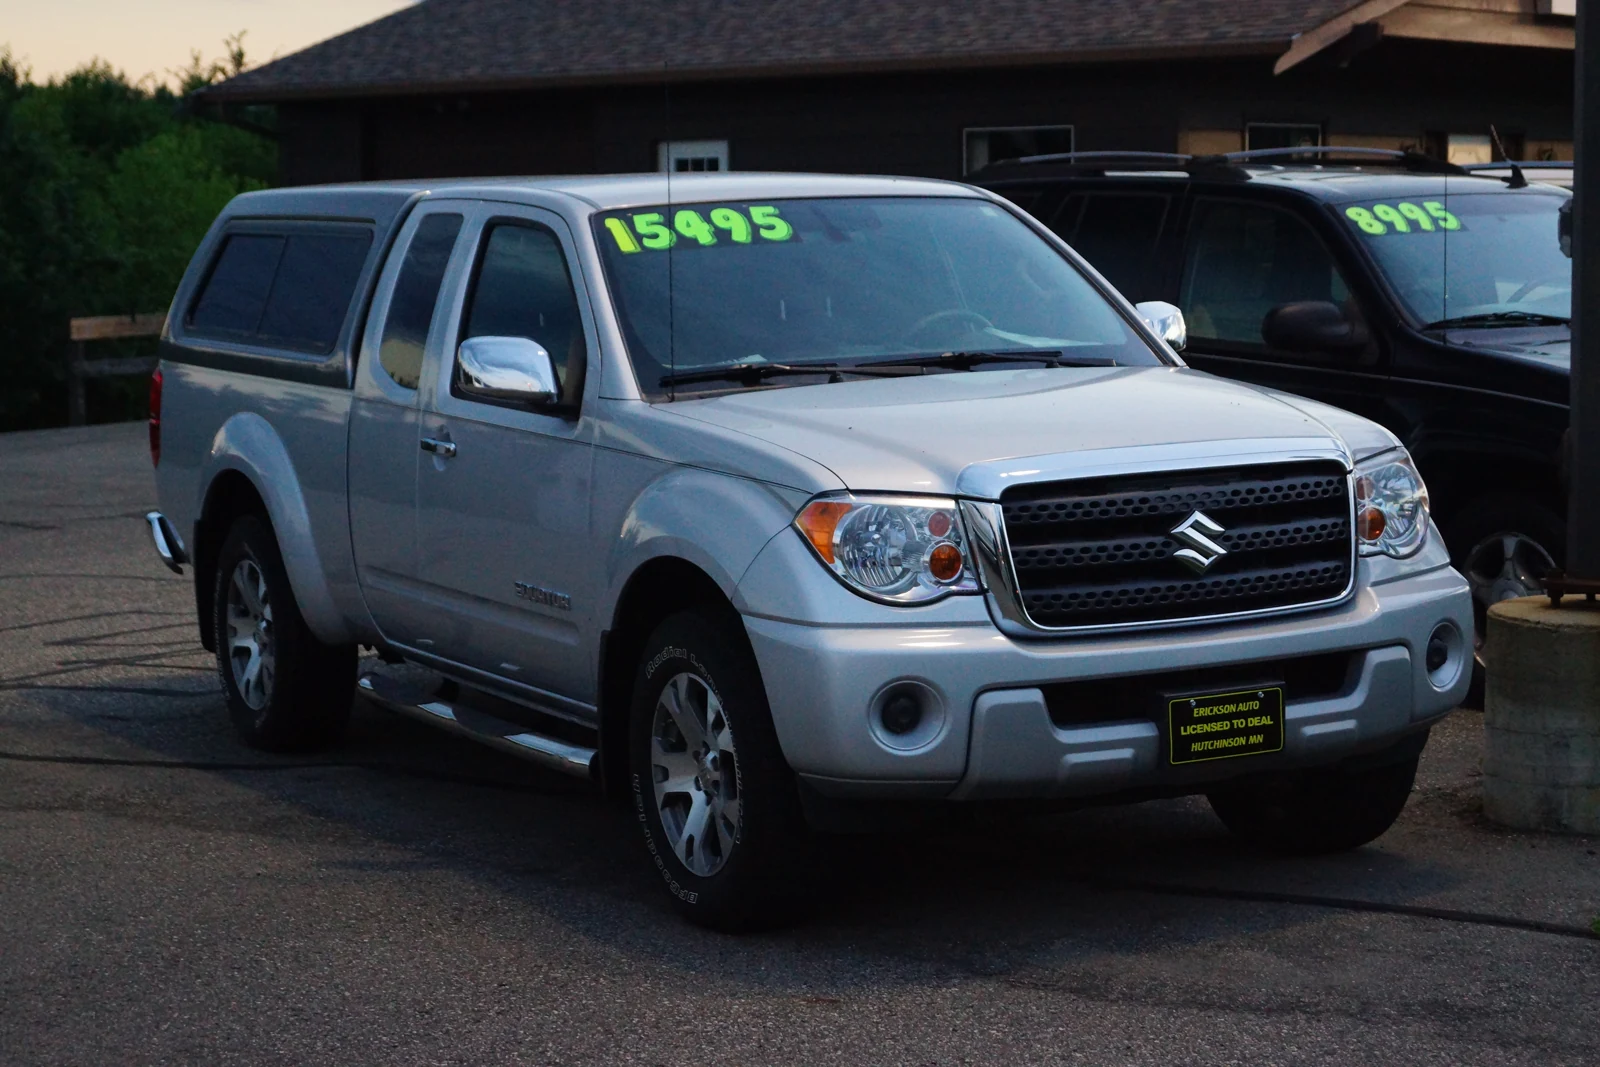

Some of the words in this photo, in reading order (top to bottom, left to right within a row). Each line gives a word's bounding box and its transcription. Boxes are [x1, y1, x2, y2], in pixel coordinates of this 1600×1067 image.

[604, 206, 793, 254] 15495
[1345, 201, 1461, 235] 8995
[645, 645, 688, 679] Radial
[1193, 703, 1237, 718] ERICKSON
[1237, 700, 1260, 712] AUTO
[1180, 720, 1231, 736] LICENSED
[1232, 718, 1246, 729] TO
[1247, 715, 1274, 728] DEAL
[1190, 736, 1247, 752] HUTCHINSON
[1248, 734, 1264, 745] MN
